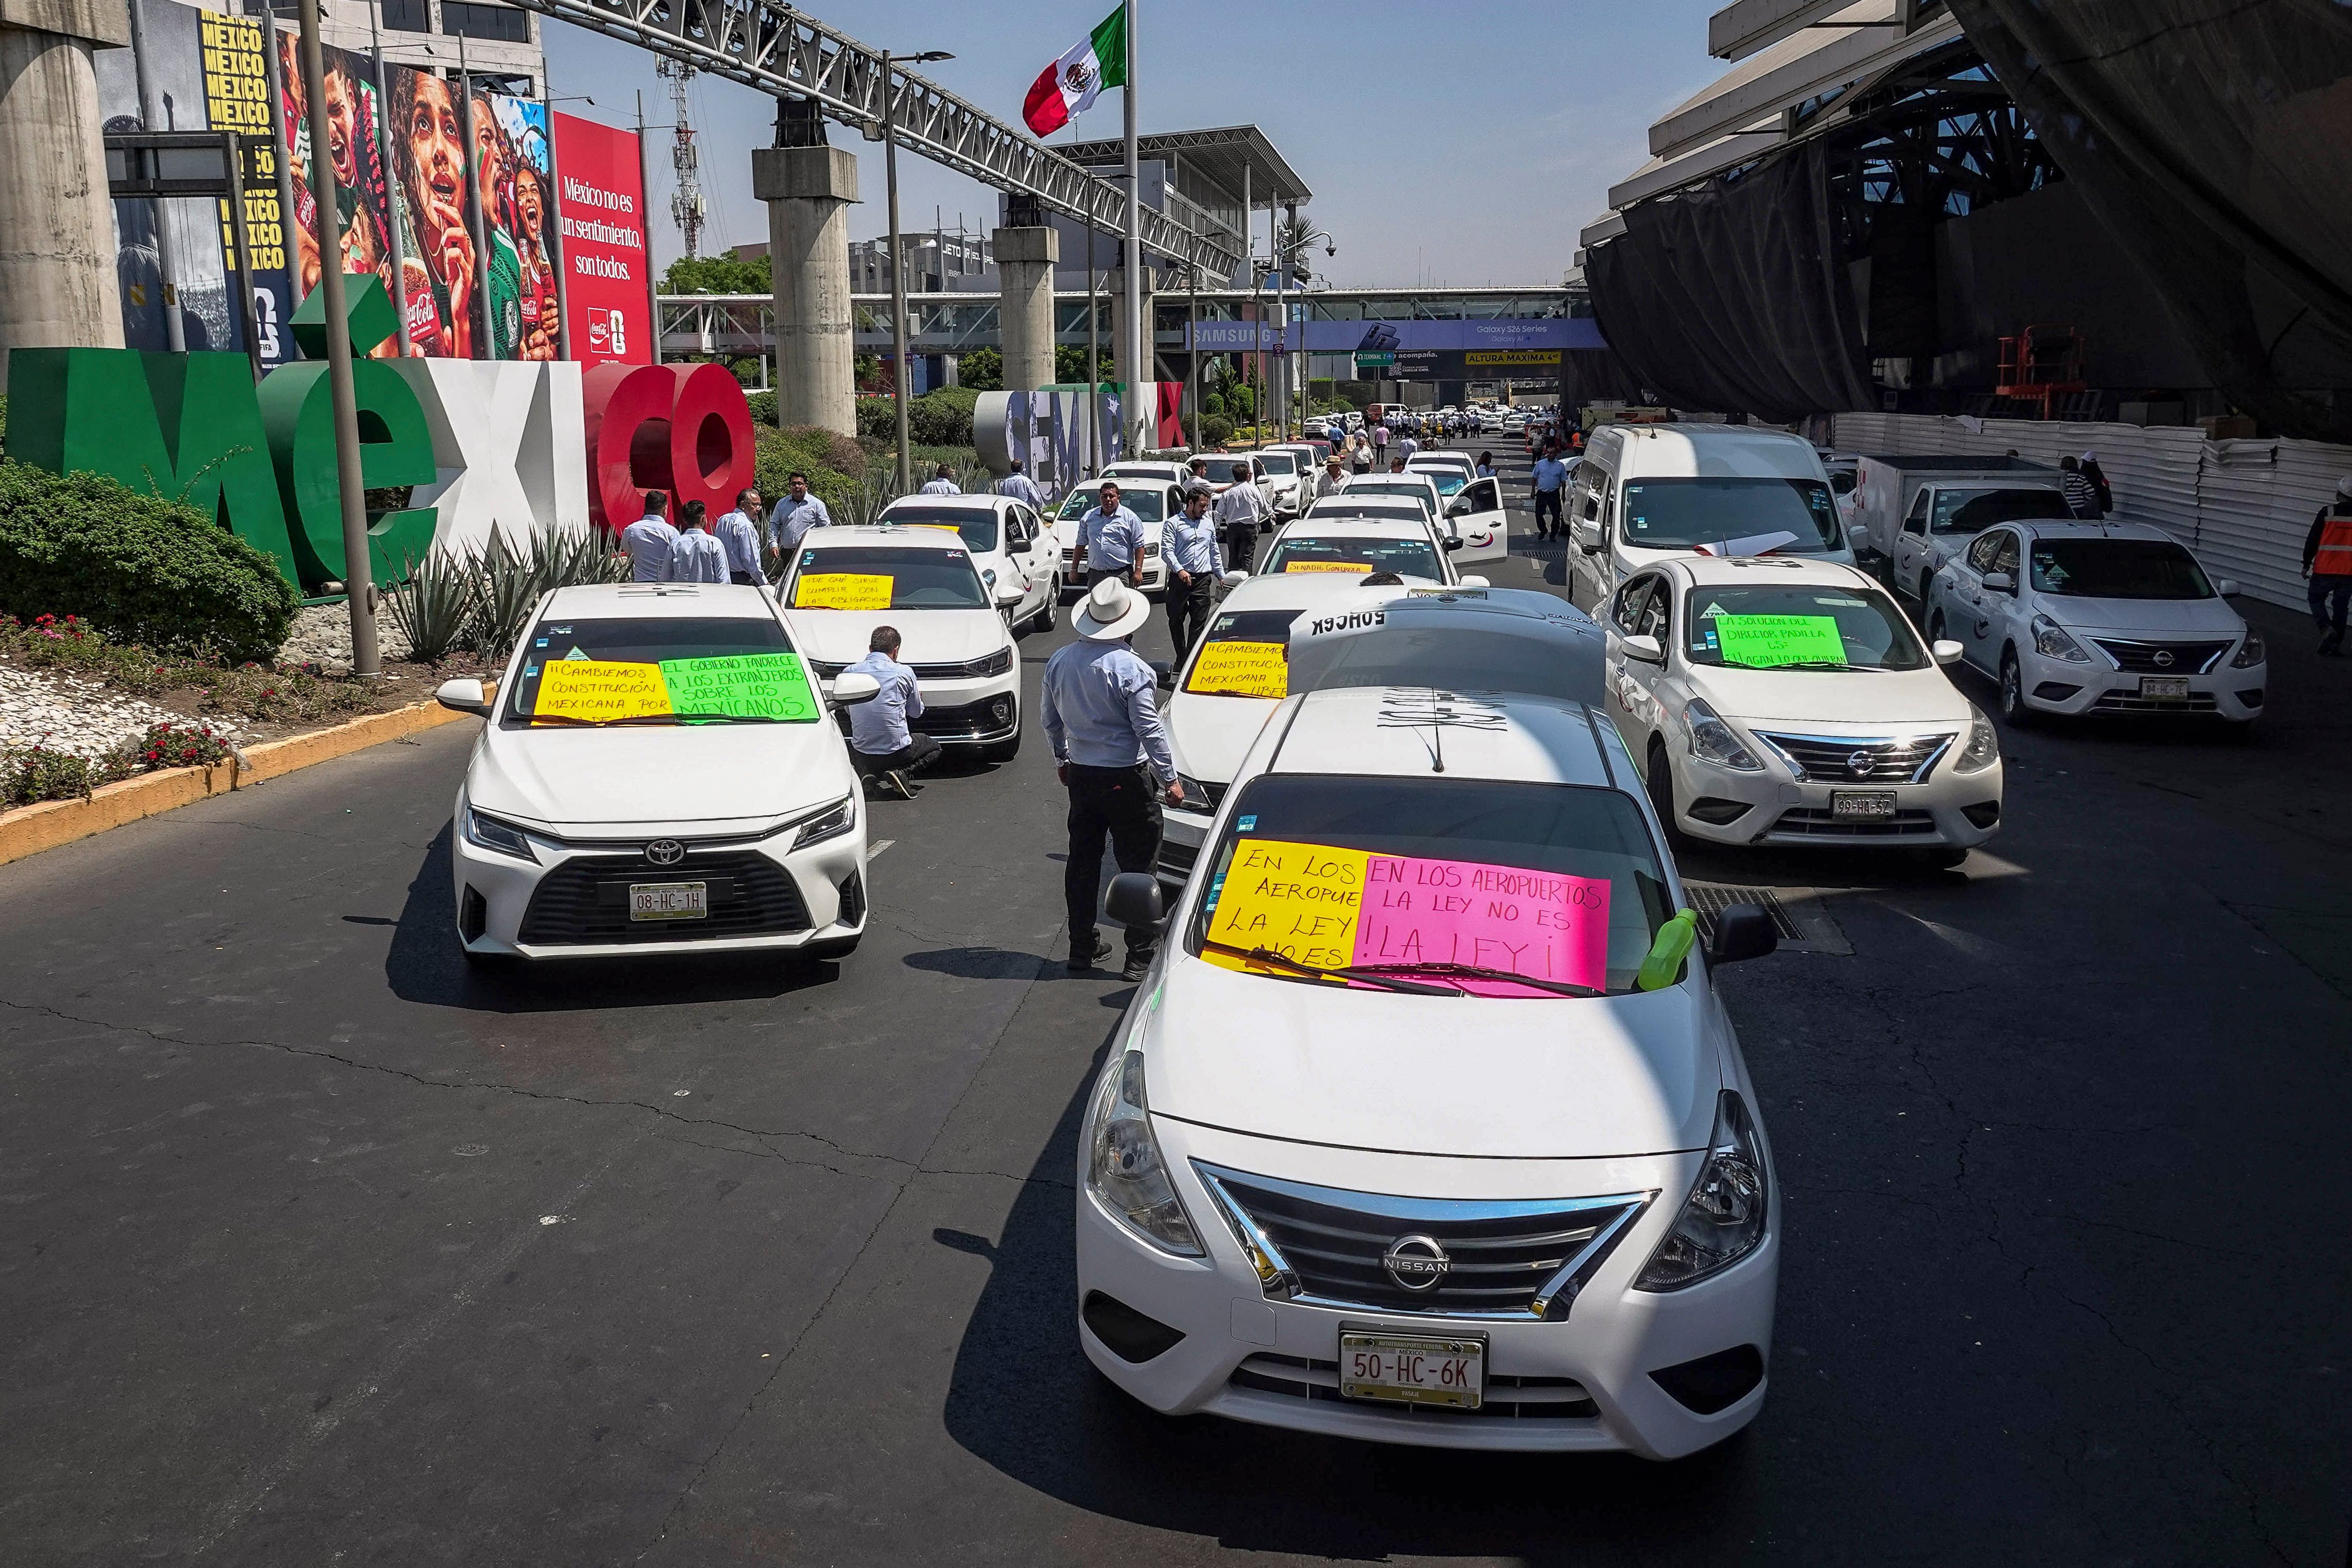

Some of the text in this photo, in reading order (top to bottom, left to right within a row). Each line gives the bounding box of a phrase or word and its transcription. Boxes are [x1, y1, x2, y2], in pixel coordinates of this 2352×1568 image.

[563, 176, 633, 213] México no es
[219, 199, 280, 222] MXICO
[223, 223, 283, 246] MXICO
[561, 216, 642, 251] un sentimiento,
[225, 247, 285, 271] MXICO
[575, 255, 630, 280] son todos.
[1195, 329, 1271, 342] SAMSUNG
[1477, 325, 1506, 334] Galaxy
[1717, 617, 1734, 626] LA
[662, 656, 795, 673] EL GOBIERNO FAVORECE
[1203, 660, 1287, 671] CONSTITUCIO
[668, 668, 804, 689] A LOS EXTRANJEROS
[1200, 674, 1267, 685] MEXICANA
[683, 684, 778, 701] SOBRE LOS
[547, 699, 670, 710] MEXICANA POR
[1243, 849, 1355, 884] EN LOS
[1369, 860, 1602, 909] EN LOS AEROPUERTOS
[1383, 889, 1570, 930] LA LEY NO ES
[1226, 907, 1352, 938] LA LEY
[1302, 948, 1344, 966] ES
[1384, 1258, 1448, 1272] NISSAN
[1354, 1353, 1469, 1387] 50-HC-6K
